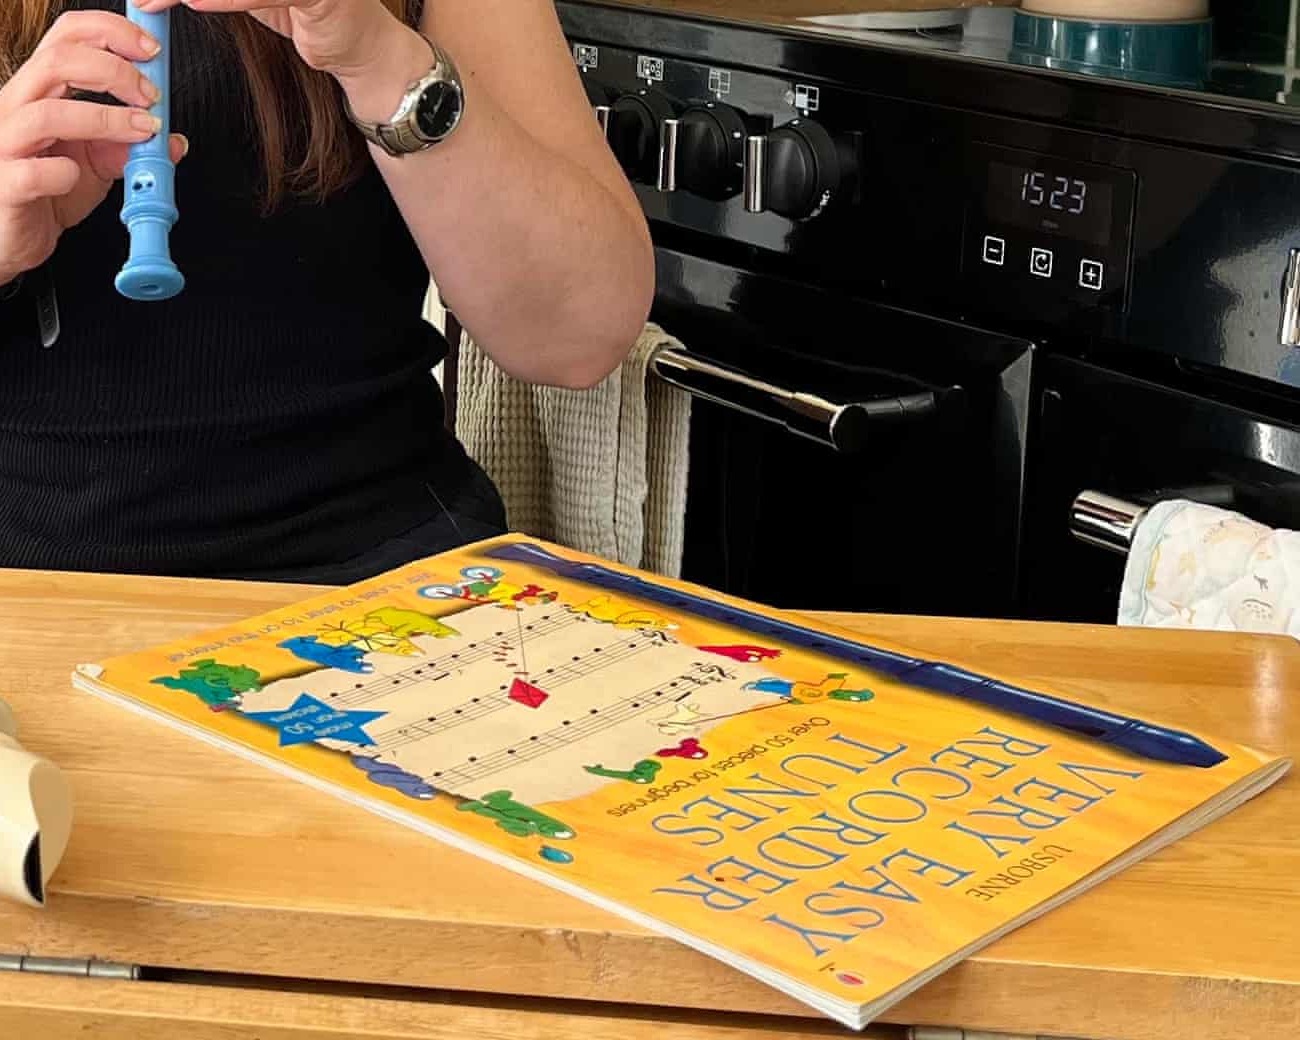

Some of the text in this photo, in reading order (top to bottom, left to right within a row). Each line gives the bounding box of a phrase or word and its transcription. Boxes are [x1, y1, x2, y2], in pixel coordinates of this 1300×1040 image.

[605, 716, 831, 818] Over 50 pieces for beginners
[651, 733, 908, 846] TUNES
[652, 727, 1052, 911] RECORDER
[763, 759, 1145, 958] VERY EASY
[965, 843, 1073, 904] USBORNE
